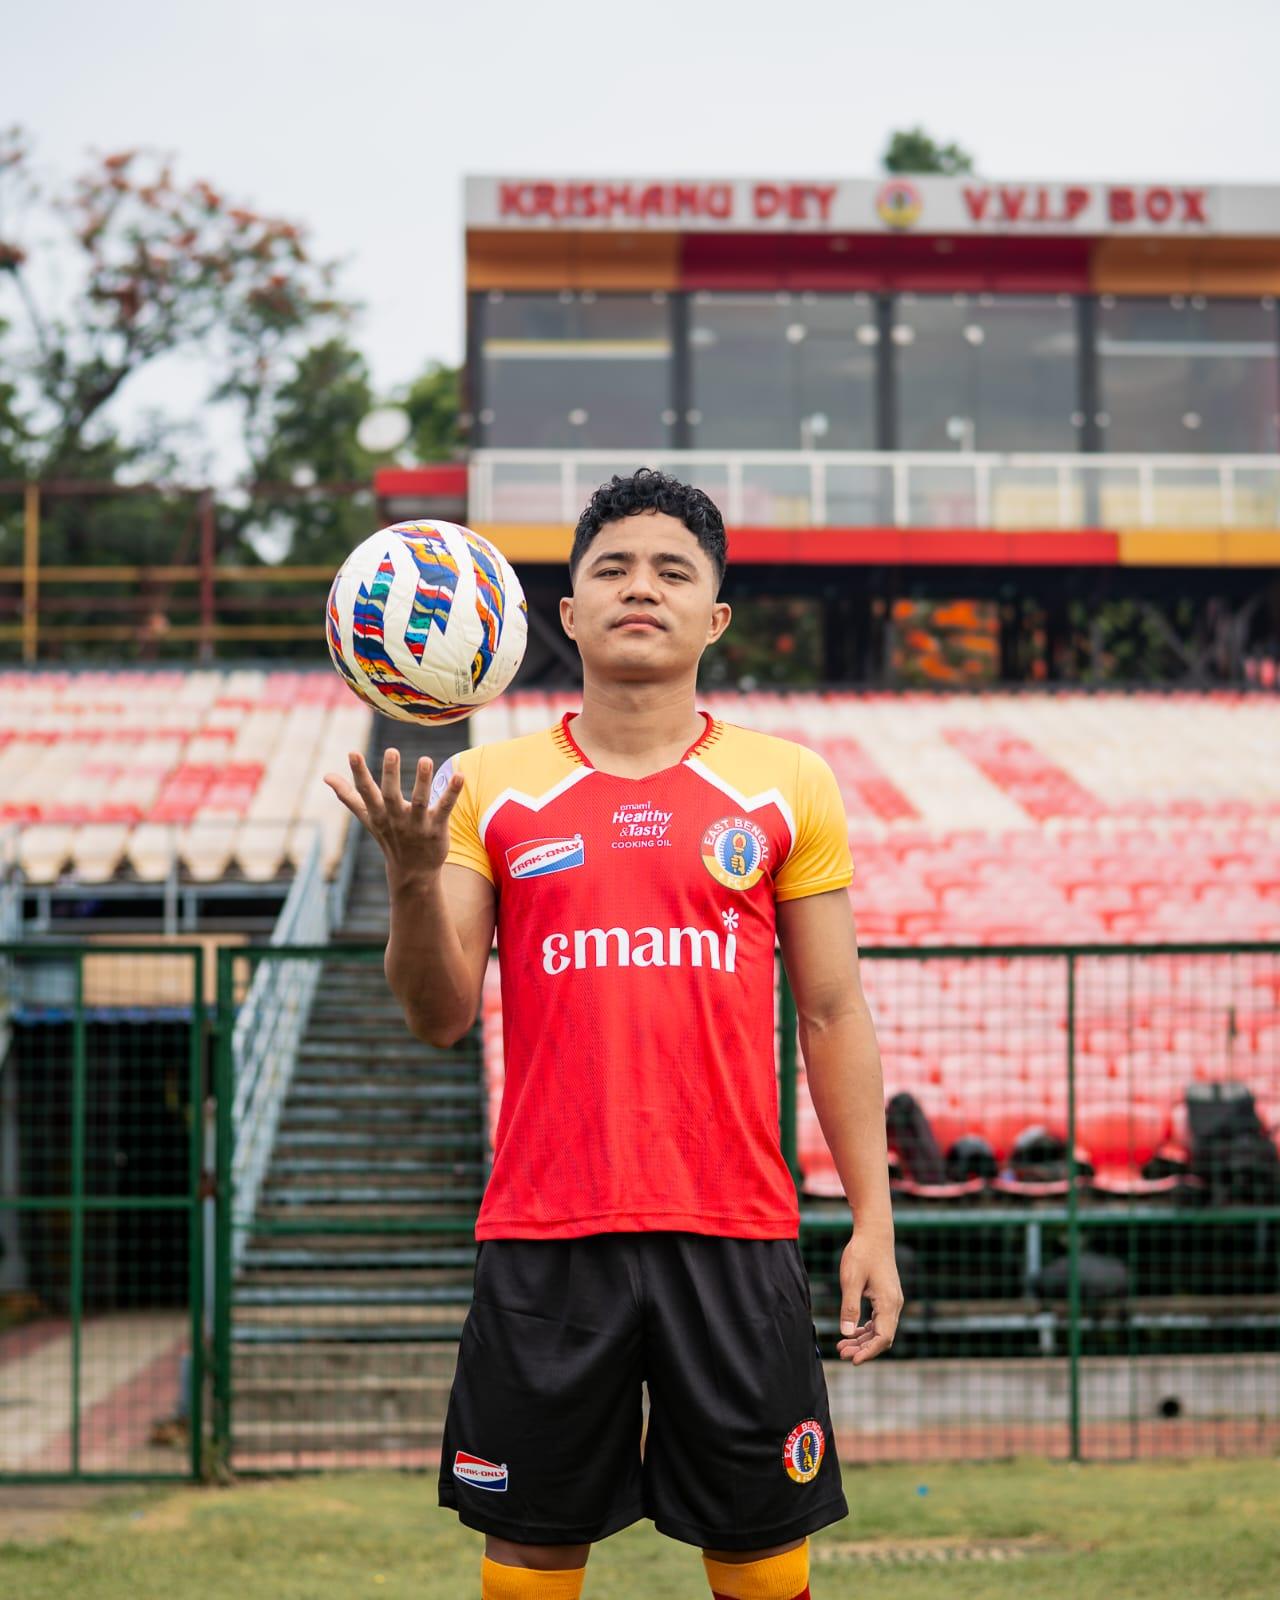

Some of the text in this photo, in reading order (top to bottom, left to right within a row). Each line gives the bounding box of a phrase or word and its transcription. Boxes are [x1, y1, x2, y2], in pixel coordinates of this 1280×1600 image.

[753, 182, 838, 219] DEY
[1109, 187, 1206, 223] BOX
[612, 810, 673, 825] Healthy
[611, 840, 672, 849] COOKING OIL
[704, 818, 769, 862] EAST BENGAL
[511, 842, 580, 874] TRAK-ONLY
[542, 907, 740, 975] emami
[784, 1429, 800, 1458] EAST
